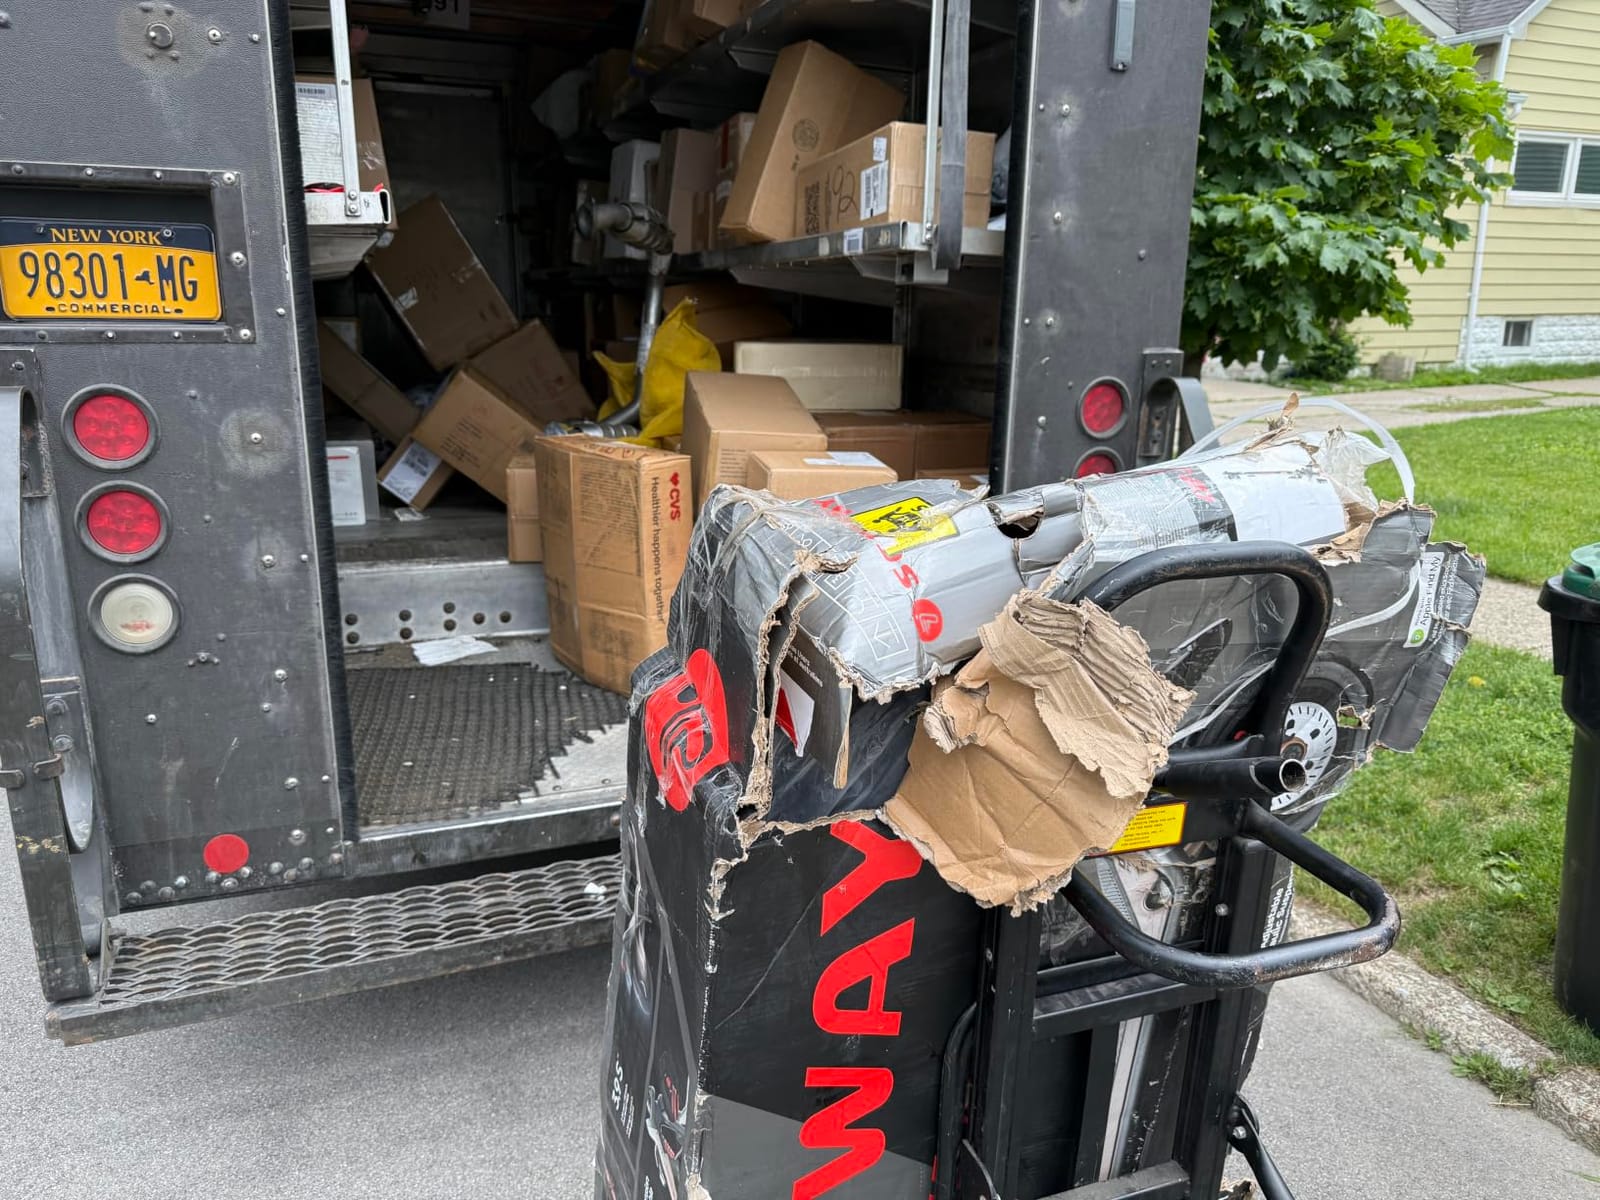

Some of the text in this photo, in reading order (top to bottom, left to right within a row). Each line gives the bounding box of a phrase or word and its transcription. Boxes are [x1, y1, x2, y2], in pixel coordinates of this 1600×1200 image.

[50, 228, 163, 246] NEW YORK
[19, 250, 199, 302] 98301 MG
[57, 303, 173, 314] COMMERCIAL
[669, 488, 681, 521] CVS
[651, 477, 666, 624] Healthier happens together
[1419, 599, 1434, 626] Apple
[1430, 556, 1442, 573] My
[1261, 887, 1284, 948] Adjustable
